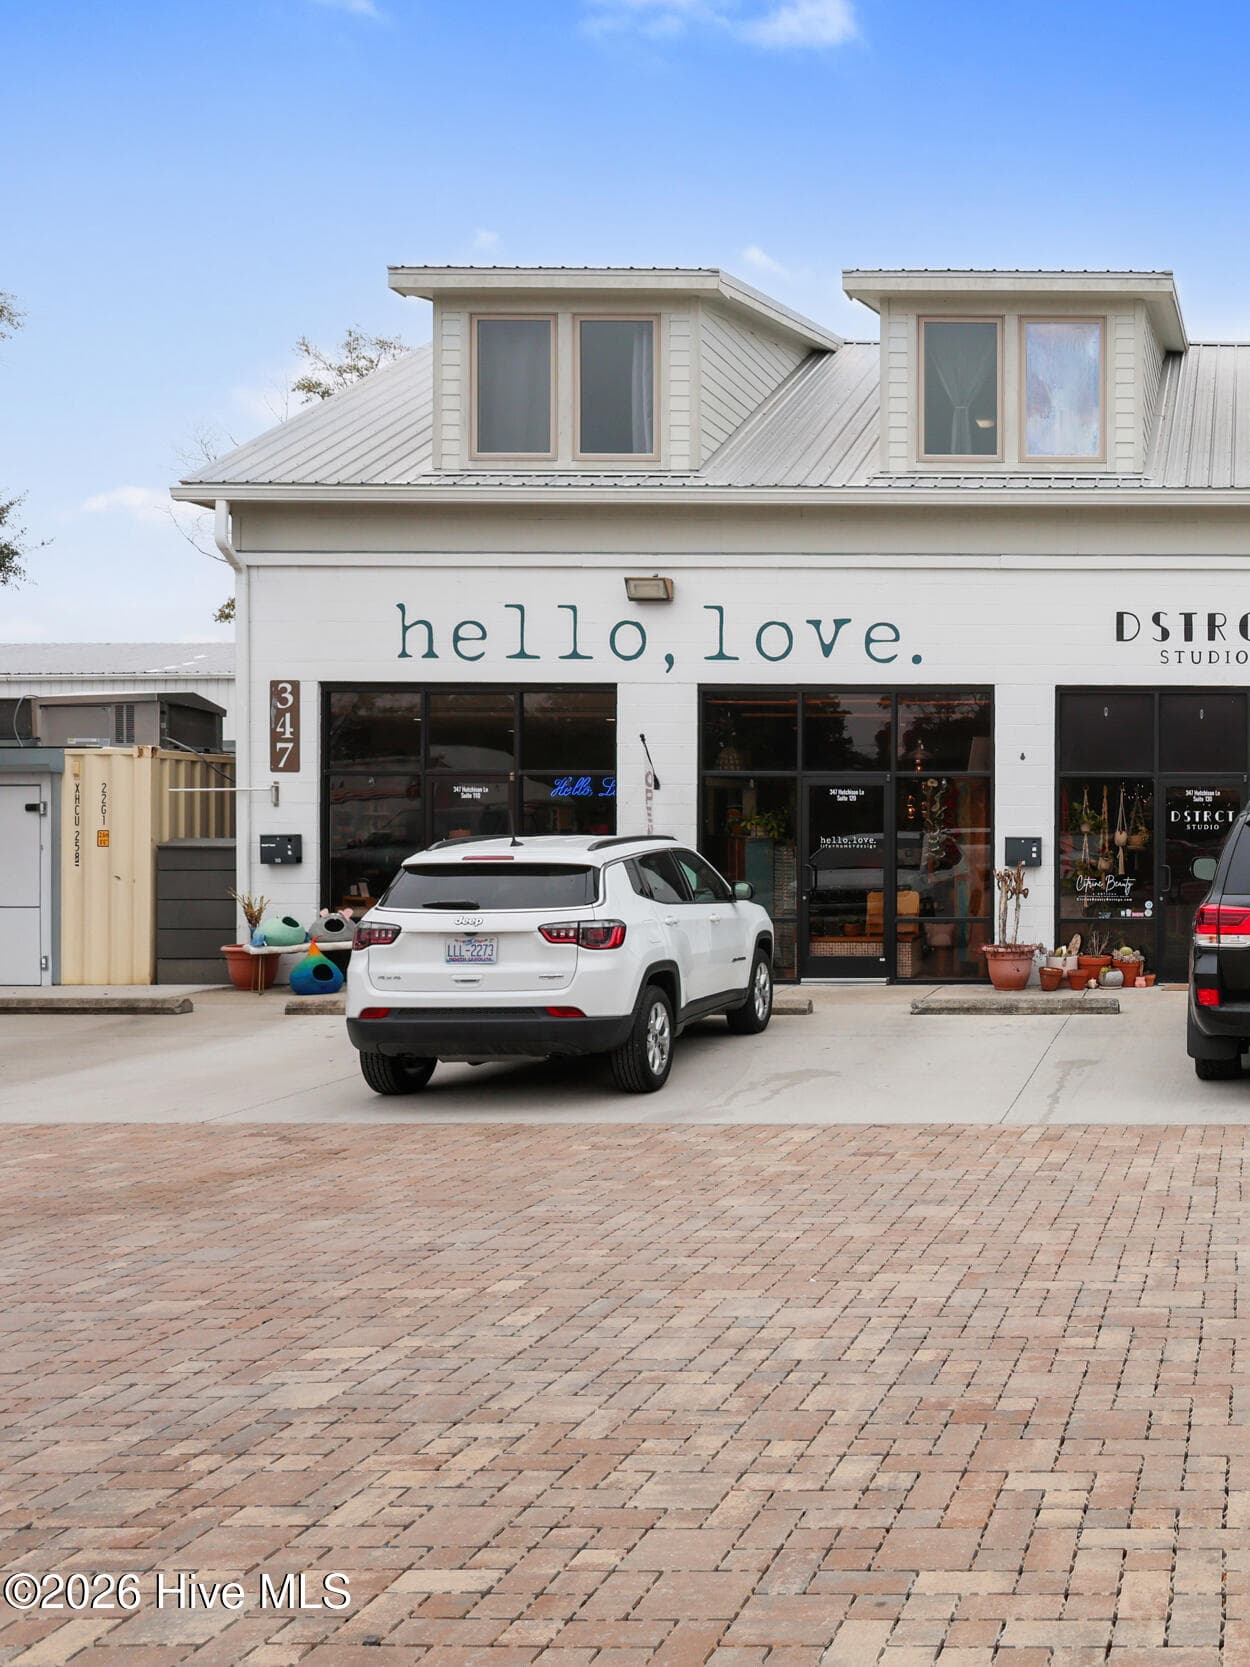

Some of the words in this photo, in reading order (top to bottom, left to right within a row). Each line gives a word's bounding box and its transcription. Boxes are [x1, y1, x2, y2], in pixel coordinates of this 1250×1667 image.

[396, 603, 675, 674] hello,
[703, 605, 923, 665] love.
[1159, 649, 1249, 665] STUDIO
[275, 682, 295, 768] 347
[550, 776, 593, 797] Hello,
[1170, 810, 1235, 823] DSTRCT
[1075, 874, 1104, 893] Citrine
[1104, 874, 1137, 896] Beauty
[453, 916, 484, 927] Jeep
[447, 943, 494, 957] LLL-2273
